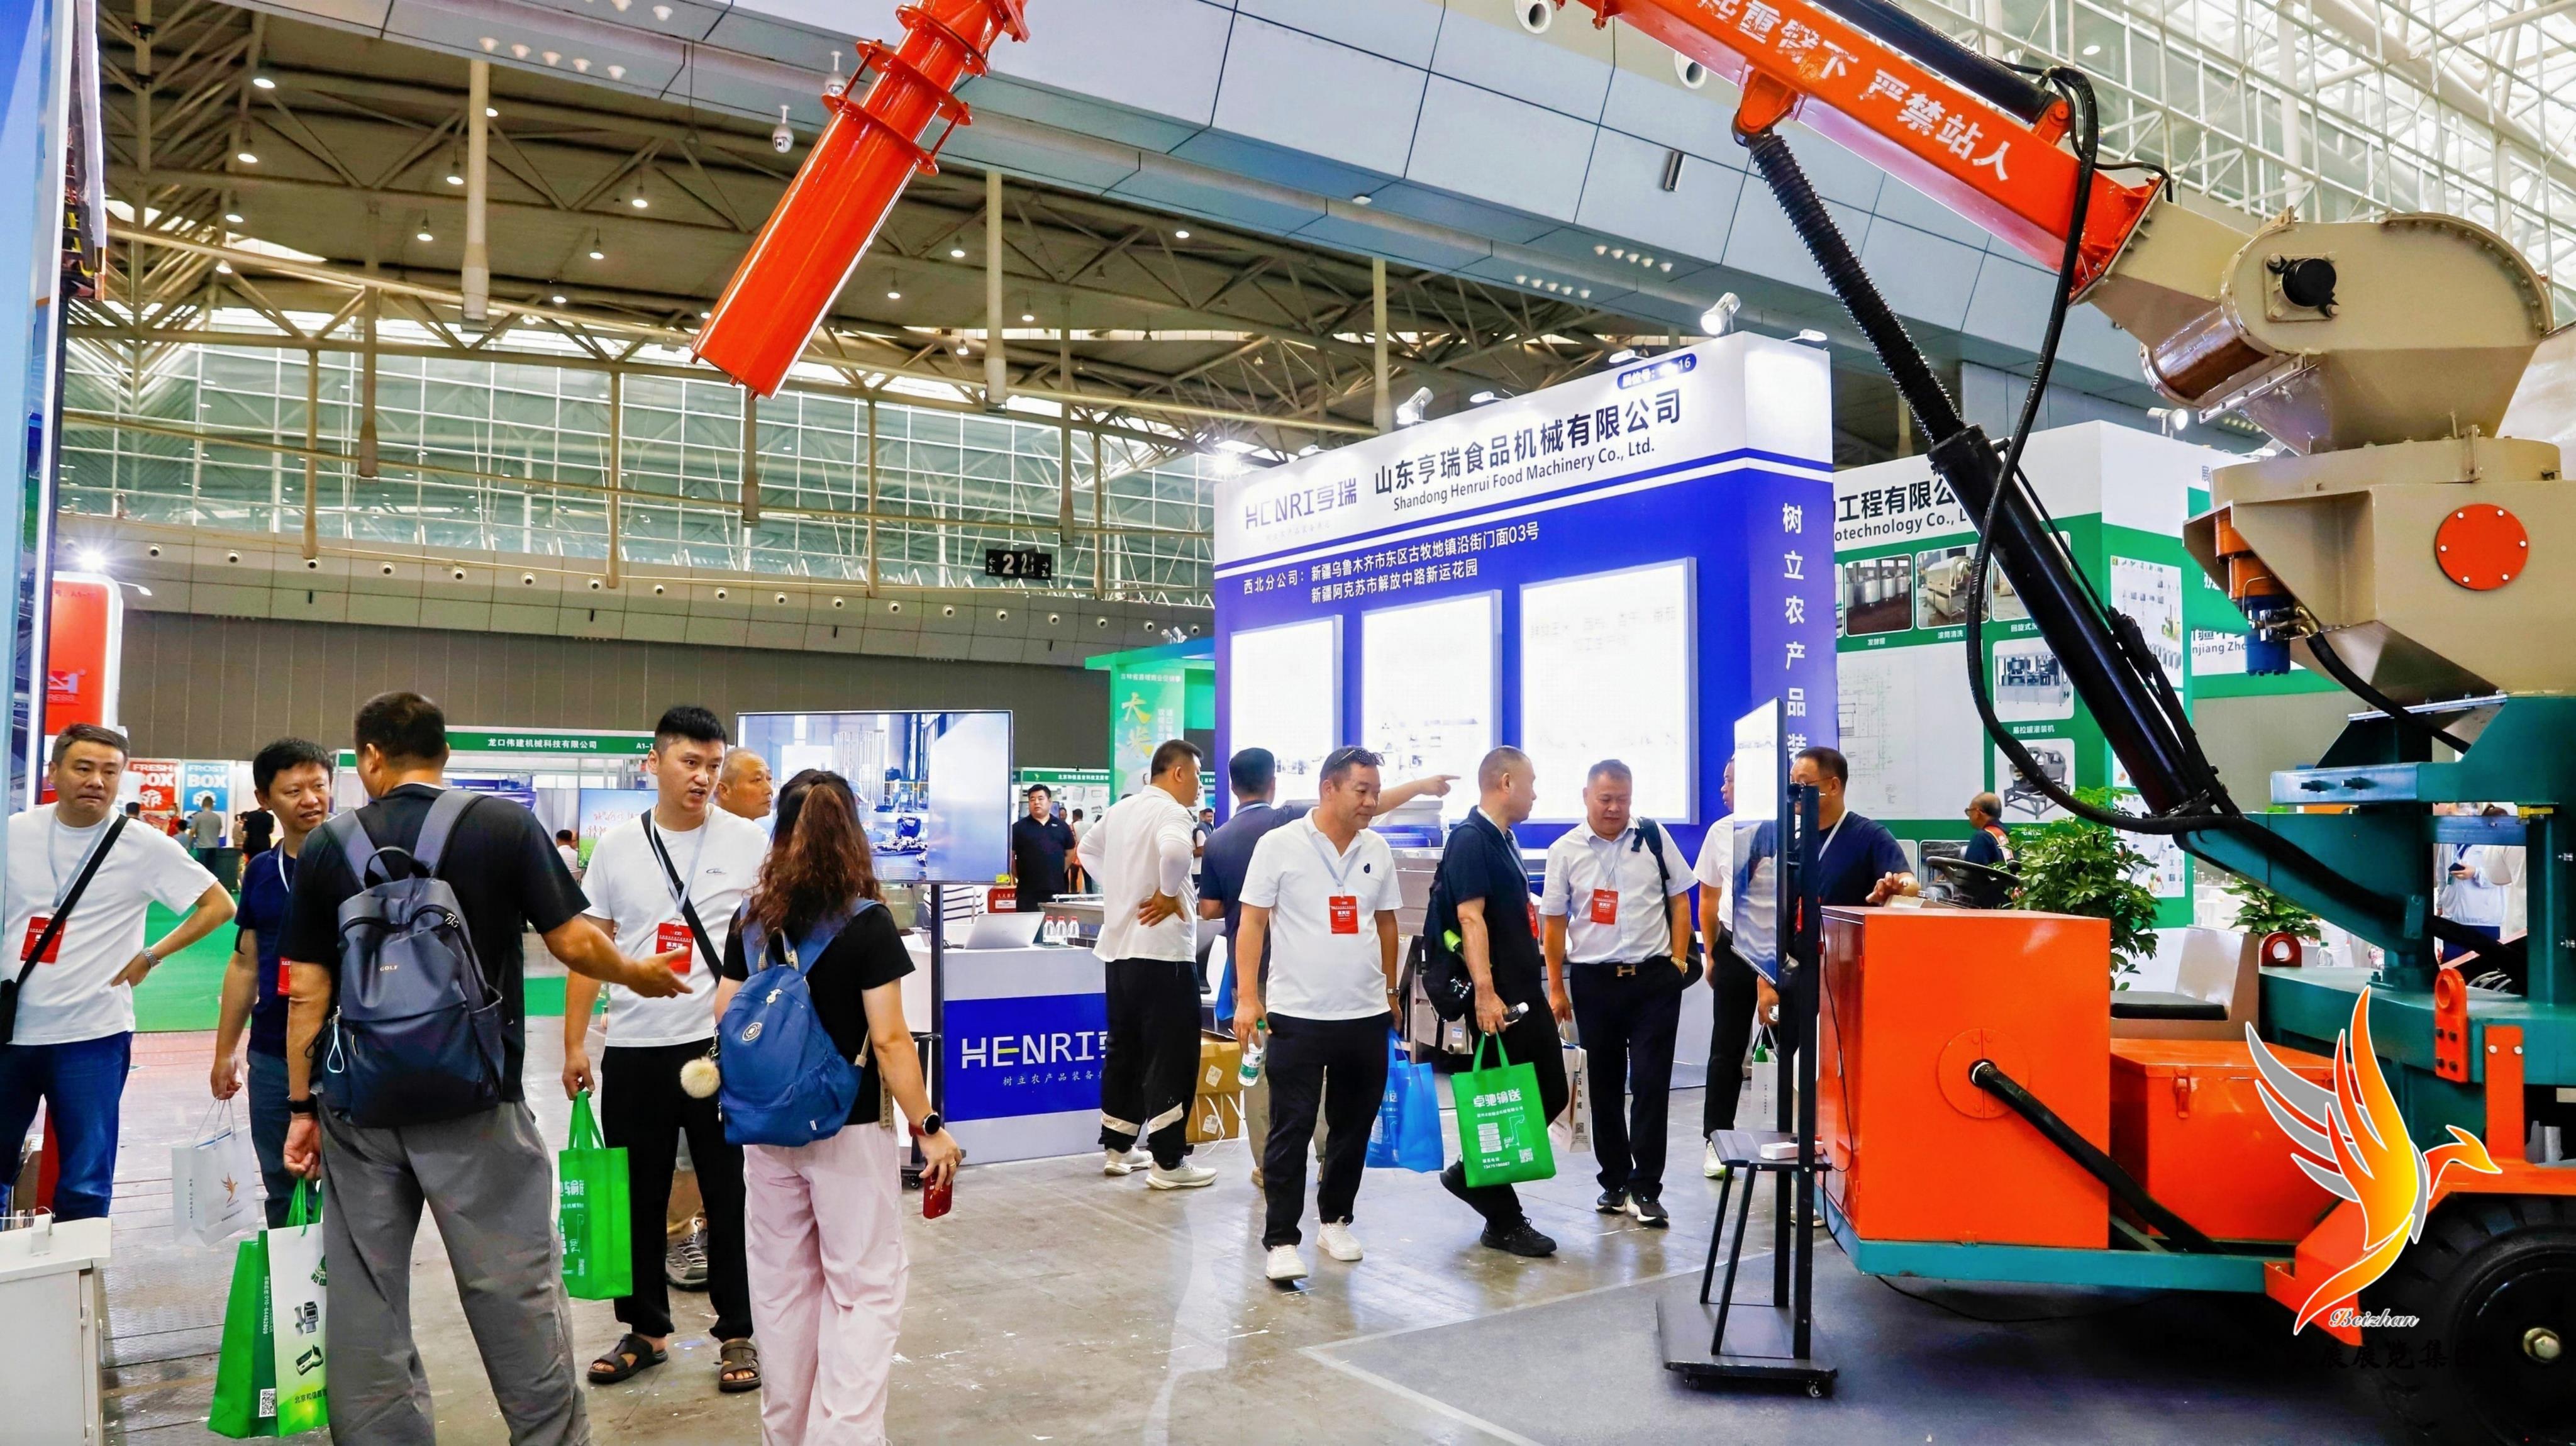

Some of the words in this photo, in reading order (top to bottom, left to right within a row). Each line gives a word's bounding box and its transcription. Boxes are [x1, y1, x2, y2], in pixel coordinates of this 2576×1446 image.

[1858, 69, 2010, 181] 严禁站人
[1375, 388, 1681, 494] 山东亨瑞食品机械有限公司
[1394, 487, 1448, 511] Shandong
[1451, 476, 1490, 499] Henrui
[1493, 468, 1523, 489] Food
[1526, 454, 1595, 481] Machinery
[1598, 446, 1624, 465] Co.,
[1628, 437, 1655, 457] Ltd.
[1834, 479, 1956, 522] 工程有限公
[1926, 512, 1955, 526] Co.,
[1243, 569, 1305, 595] 西北分公司:
[1311, 558, 1478, 604] 新疆阿克苏市解放中路新运花园
[487, 738, 597, 750] 龙口伟建机械科技有限公司
[133, 764, 173, 772] FRESH
[187, 774, 228, 787] BOX
[1474, 1088, 1522, 1108] 卓驰输送
